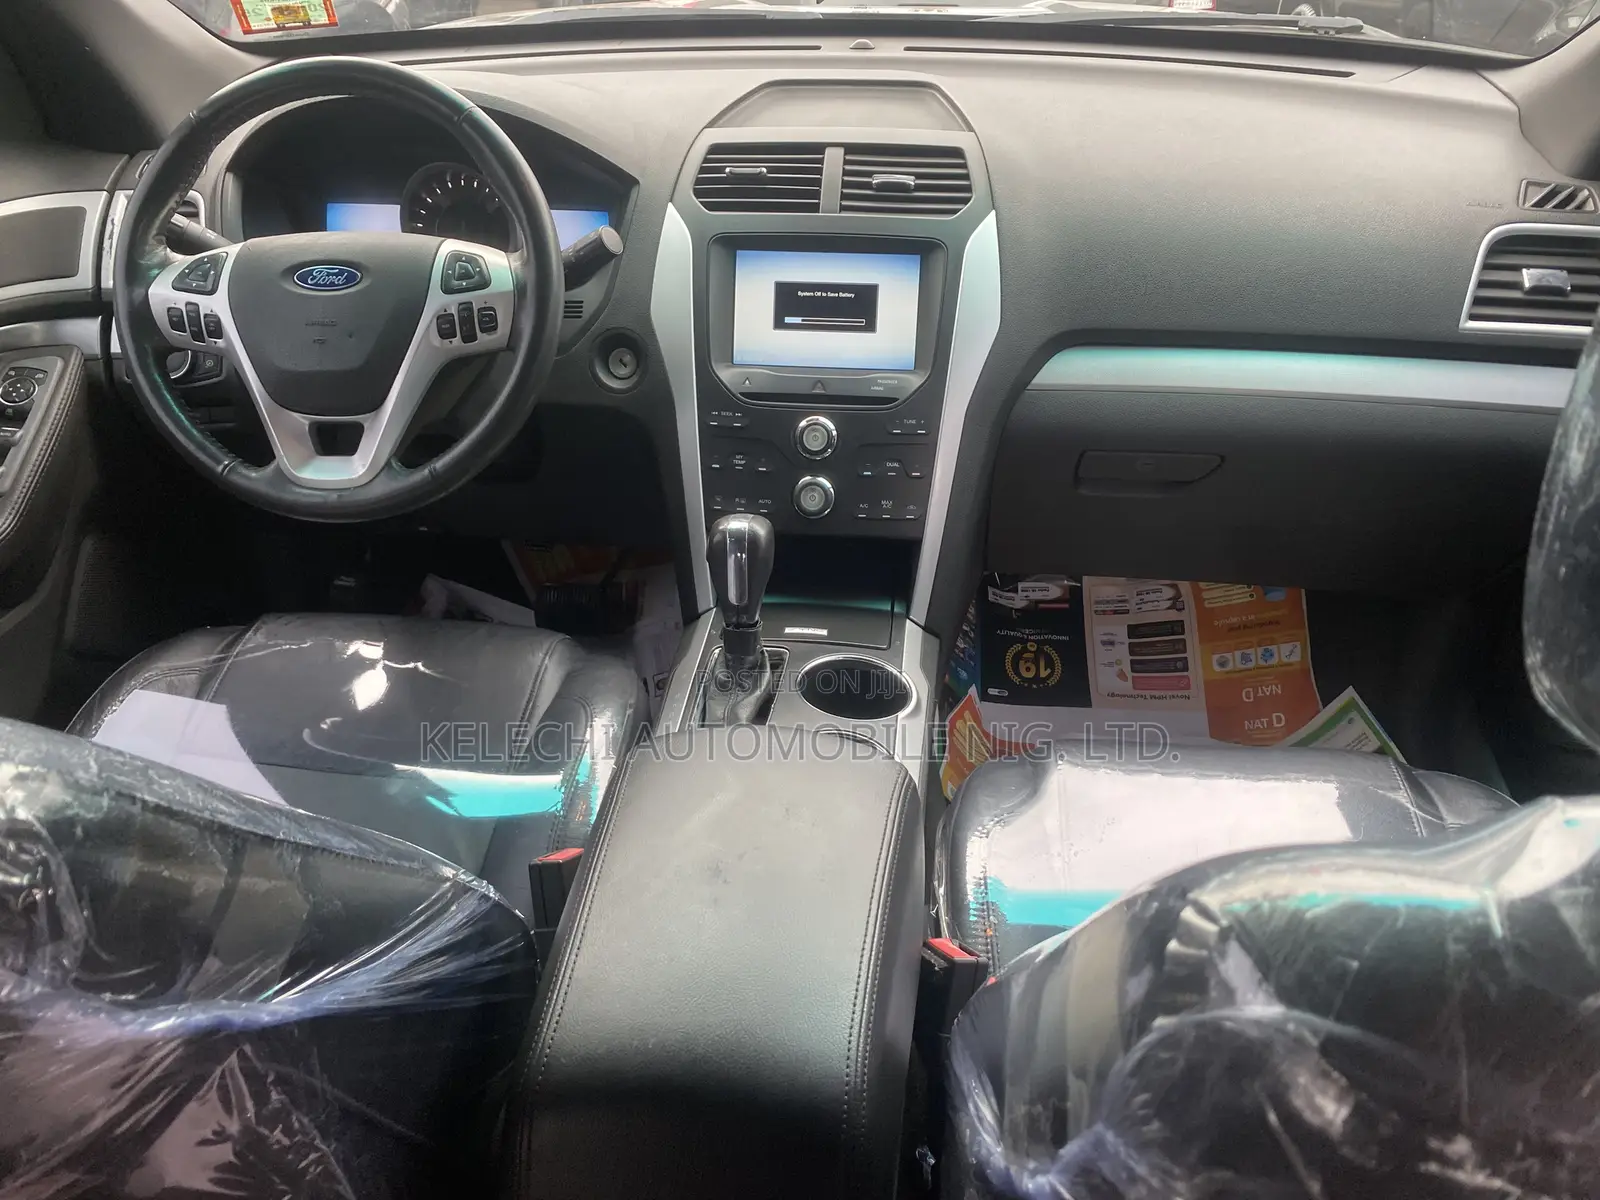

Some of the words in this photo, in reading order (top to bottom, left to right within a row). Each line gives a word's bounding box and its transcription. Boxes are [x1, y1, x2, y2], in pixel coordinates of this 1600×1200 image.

[307, 268, 347, 284] Ford
[996, 629, 1023, 638] QUALITY
[1028, 633, 1070, 641] INNOVATION
[1018, 652, 1052, 679] 19
[1107, 692, 1148, 700] Technology
[1242, 687, 1254, 702] D
[1256, 684, 1282, 696] NAT
[1244, 718, 1269, 731] NAT
[1272, 712, 1286, 728] D
